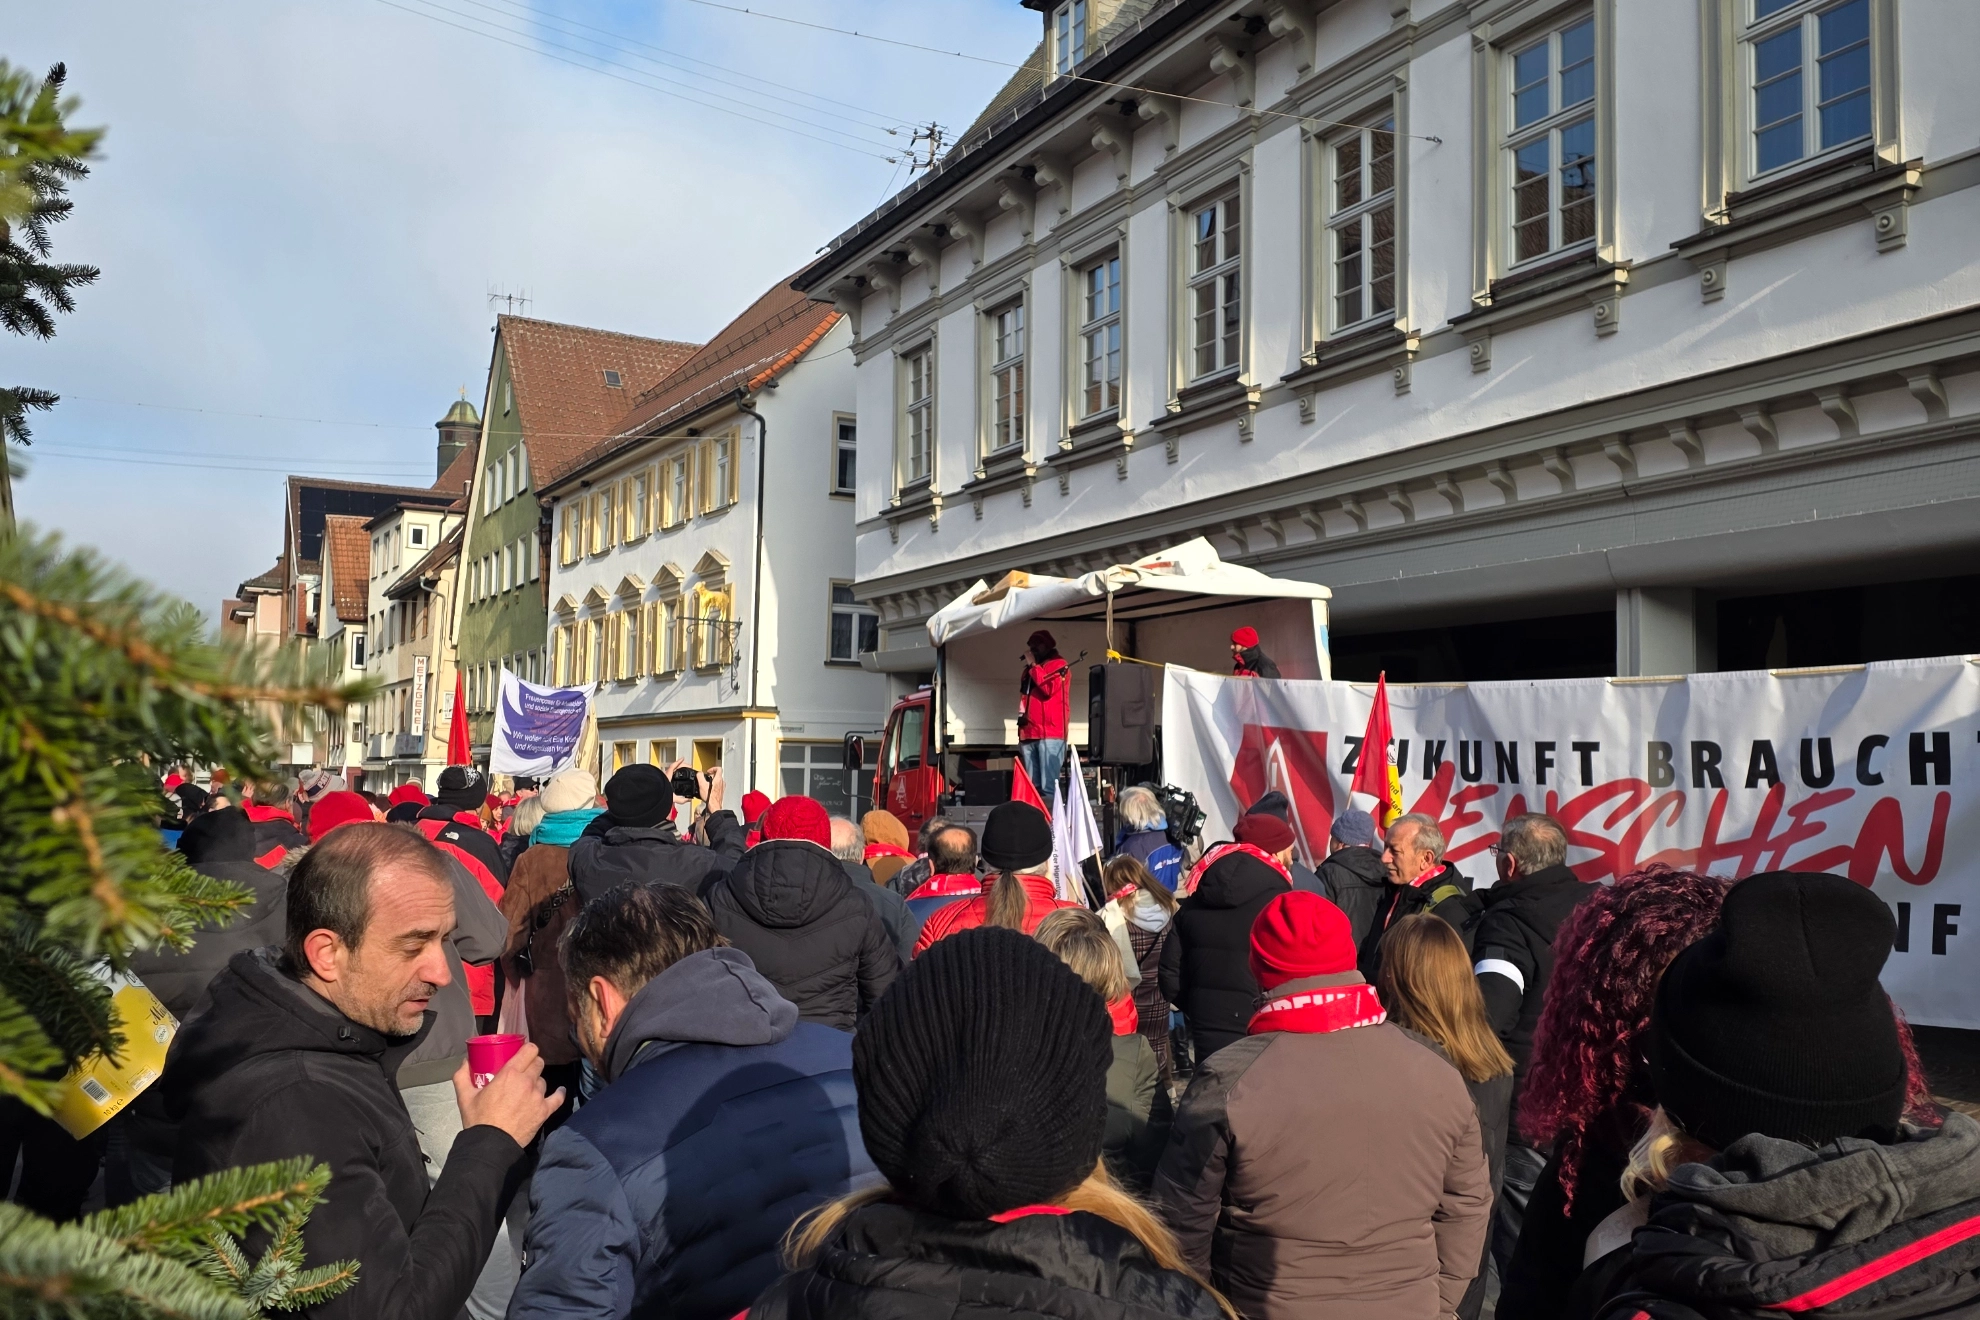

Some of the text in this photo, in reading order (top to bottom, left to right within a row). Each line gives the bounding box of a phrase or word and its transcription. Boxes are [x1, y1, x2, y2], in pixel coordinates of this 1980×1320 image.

[414, 657, 425, 733] METZGEREI
[1648, 731, 1980, 788] BRAUCH
[1390, 798, 1403, 816] tark
